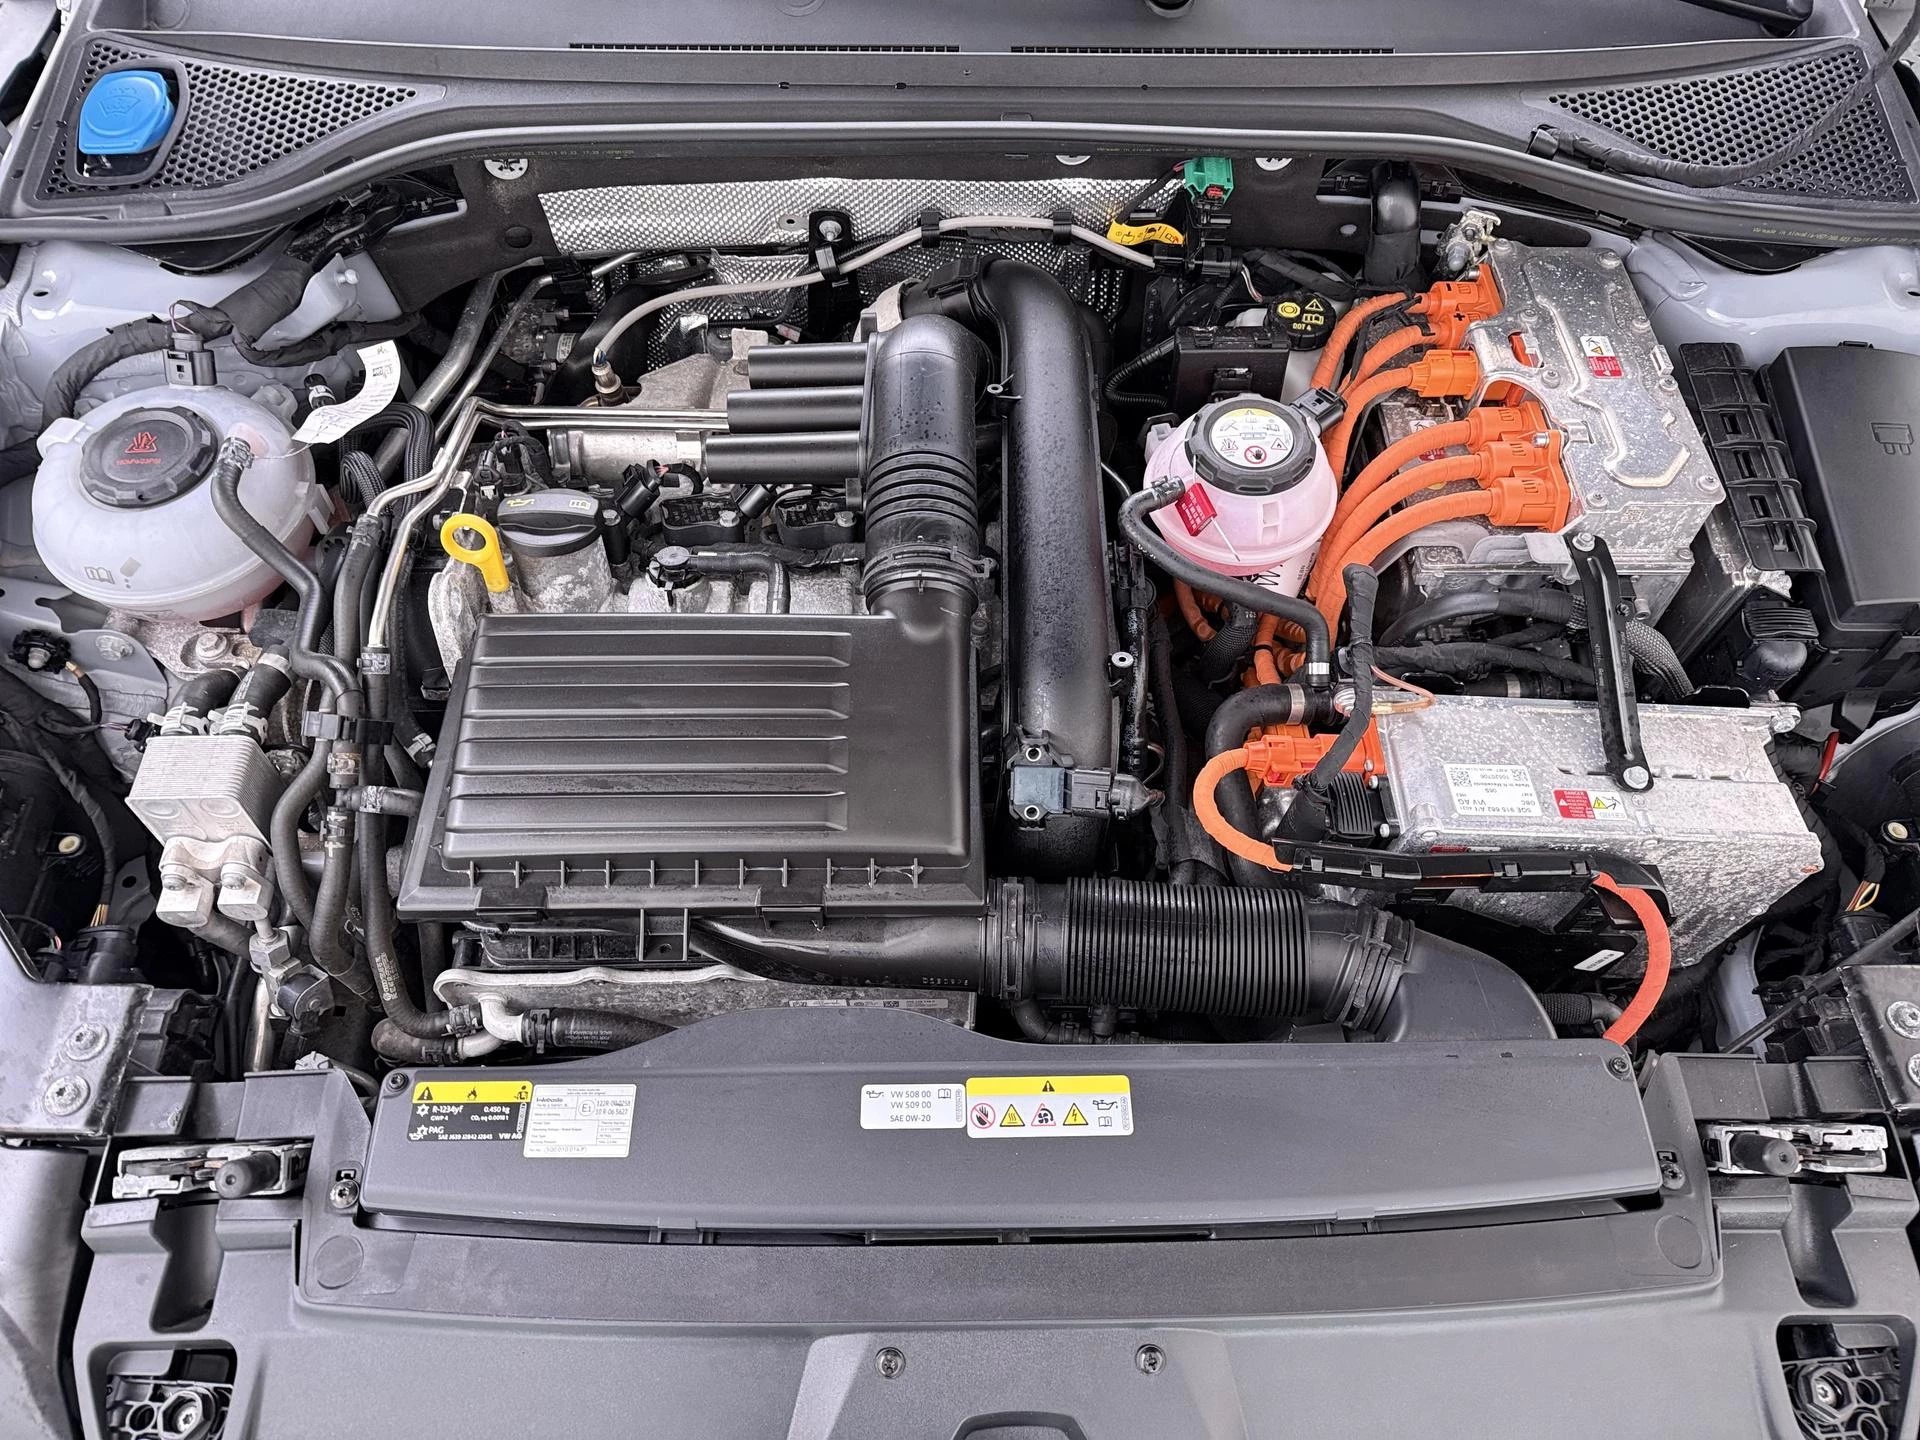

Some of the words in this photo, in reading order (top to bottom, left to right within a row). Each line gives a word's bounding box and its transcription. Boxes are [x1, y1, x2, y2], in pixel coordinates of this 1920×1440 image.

[1292, 322, 1305, 330] DOT
[432, 1105, 464, 1115] R-1234yf
[502, 1106, 510, 1114] kg
[428, 1126, 444, 1134] PAG
